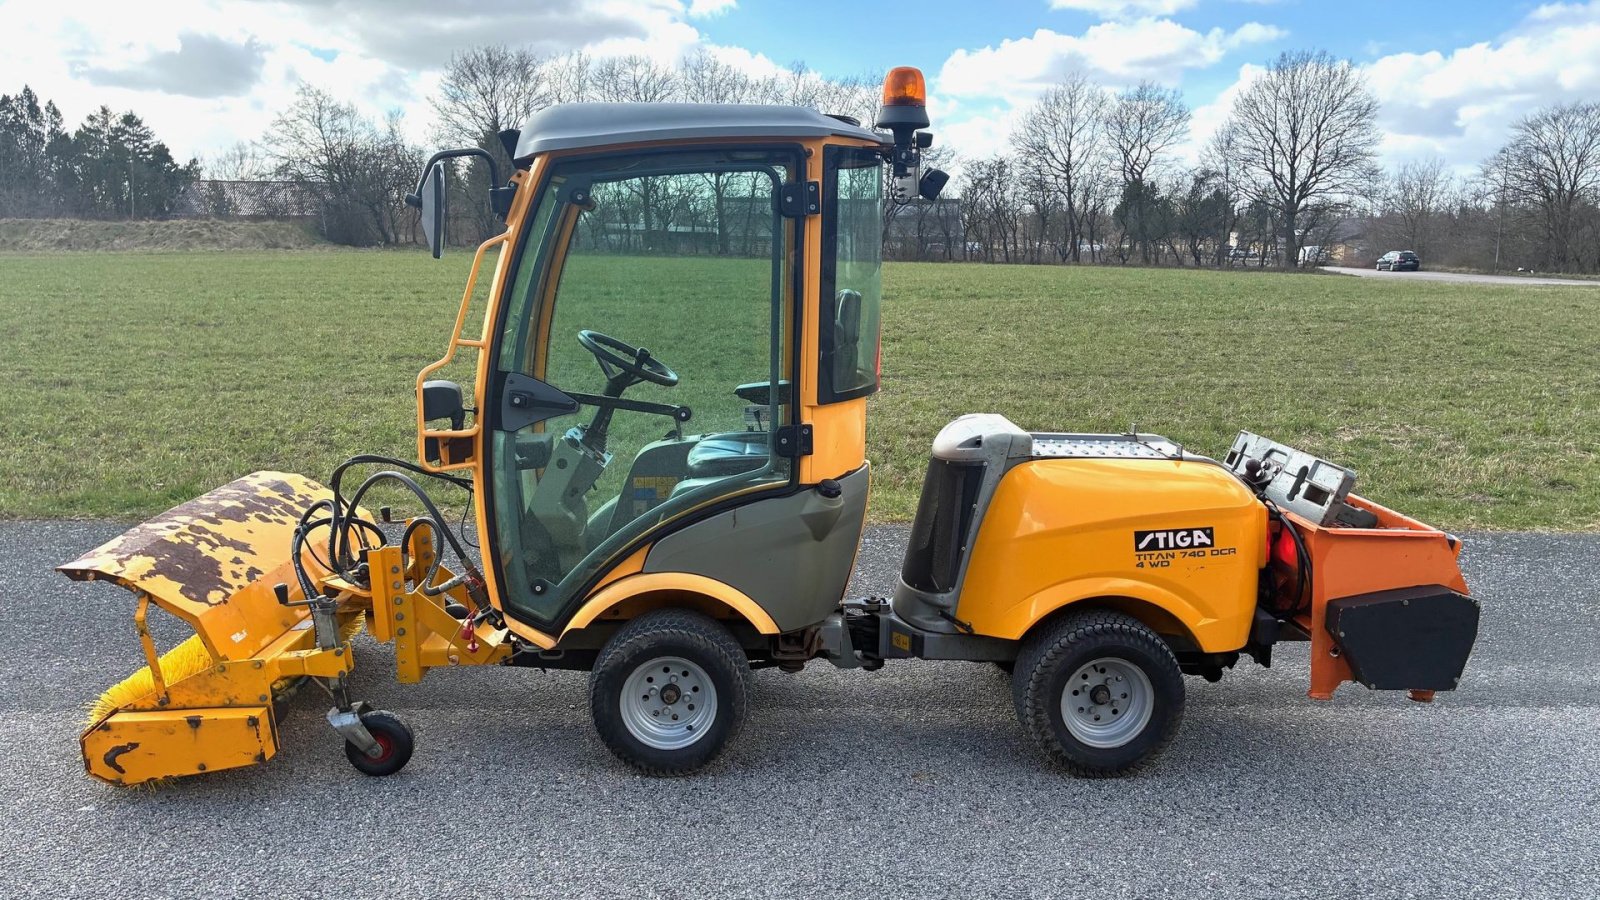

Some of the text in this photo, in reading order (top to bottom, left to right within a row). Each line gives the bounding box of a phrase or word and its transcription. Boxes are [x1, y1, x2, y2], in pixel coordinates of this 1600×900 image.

[1138, 530, 1211, 549] STIGA
[1136, 552, 1175, 560] TITAN
[1211, 548, 1236, 556] DCR
